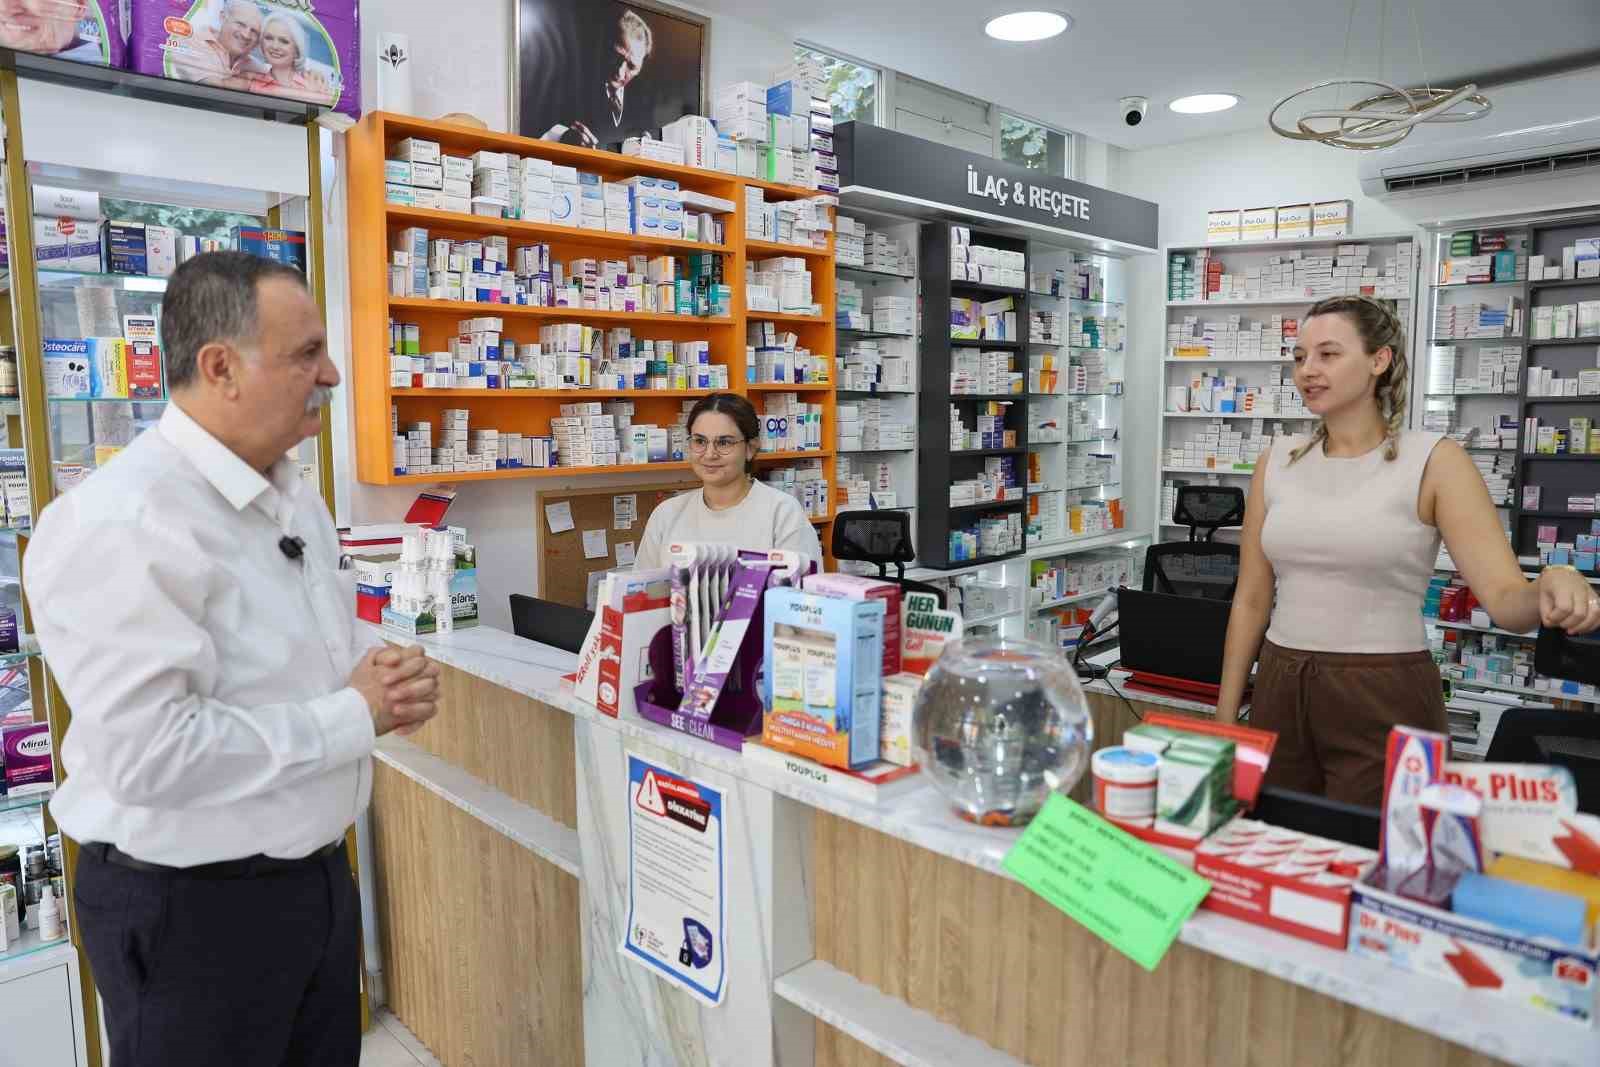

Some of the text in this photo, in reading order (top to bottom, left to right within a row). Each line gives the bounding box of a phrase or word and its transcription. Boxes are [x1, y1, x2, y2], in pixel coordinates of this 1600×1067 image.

[967, 164, 1090, 221] İLAÇ & REÇETE
[42, 342, 87, 353] Osteocare
[908, 596, 936, 613] HER
[906, 612, 954, 633] GÜNÜN
[670, 714, 715, 741] SEE CLEAN
[785, 760, 829, 783] YOUPLUS
[1488, 773, 1558, 802] Plus
